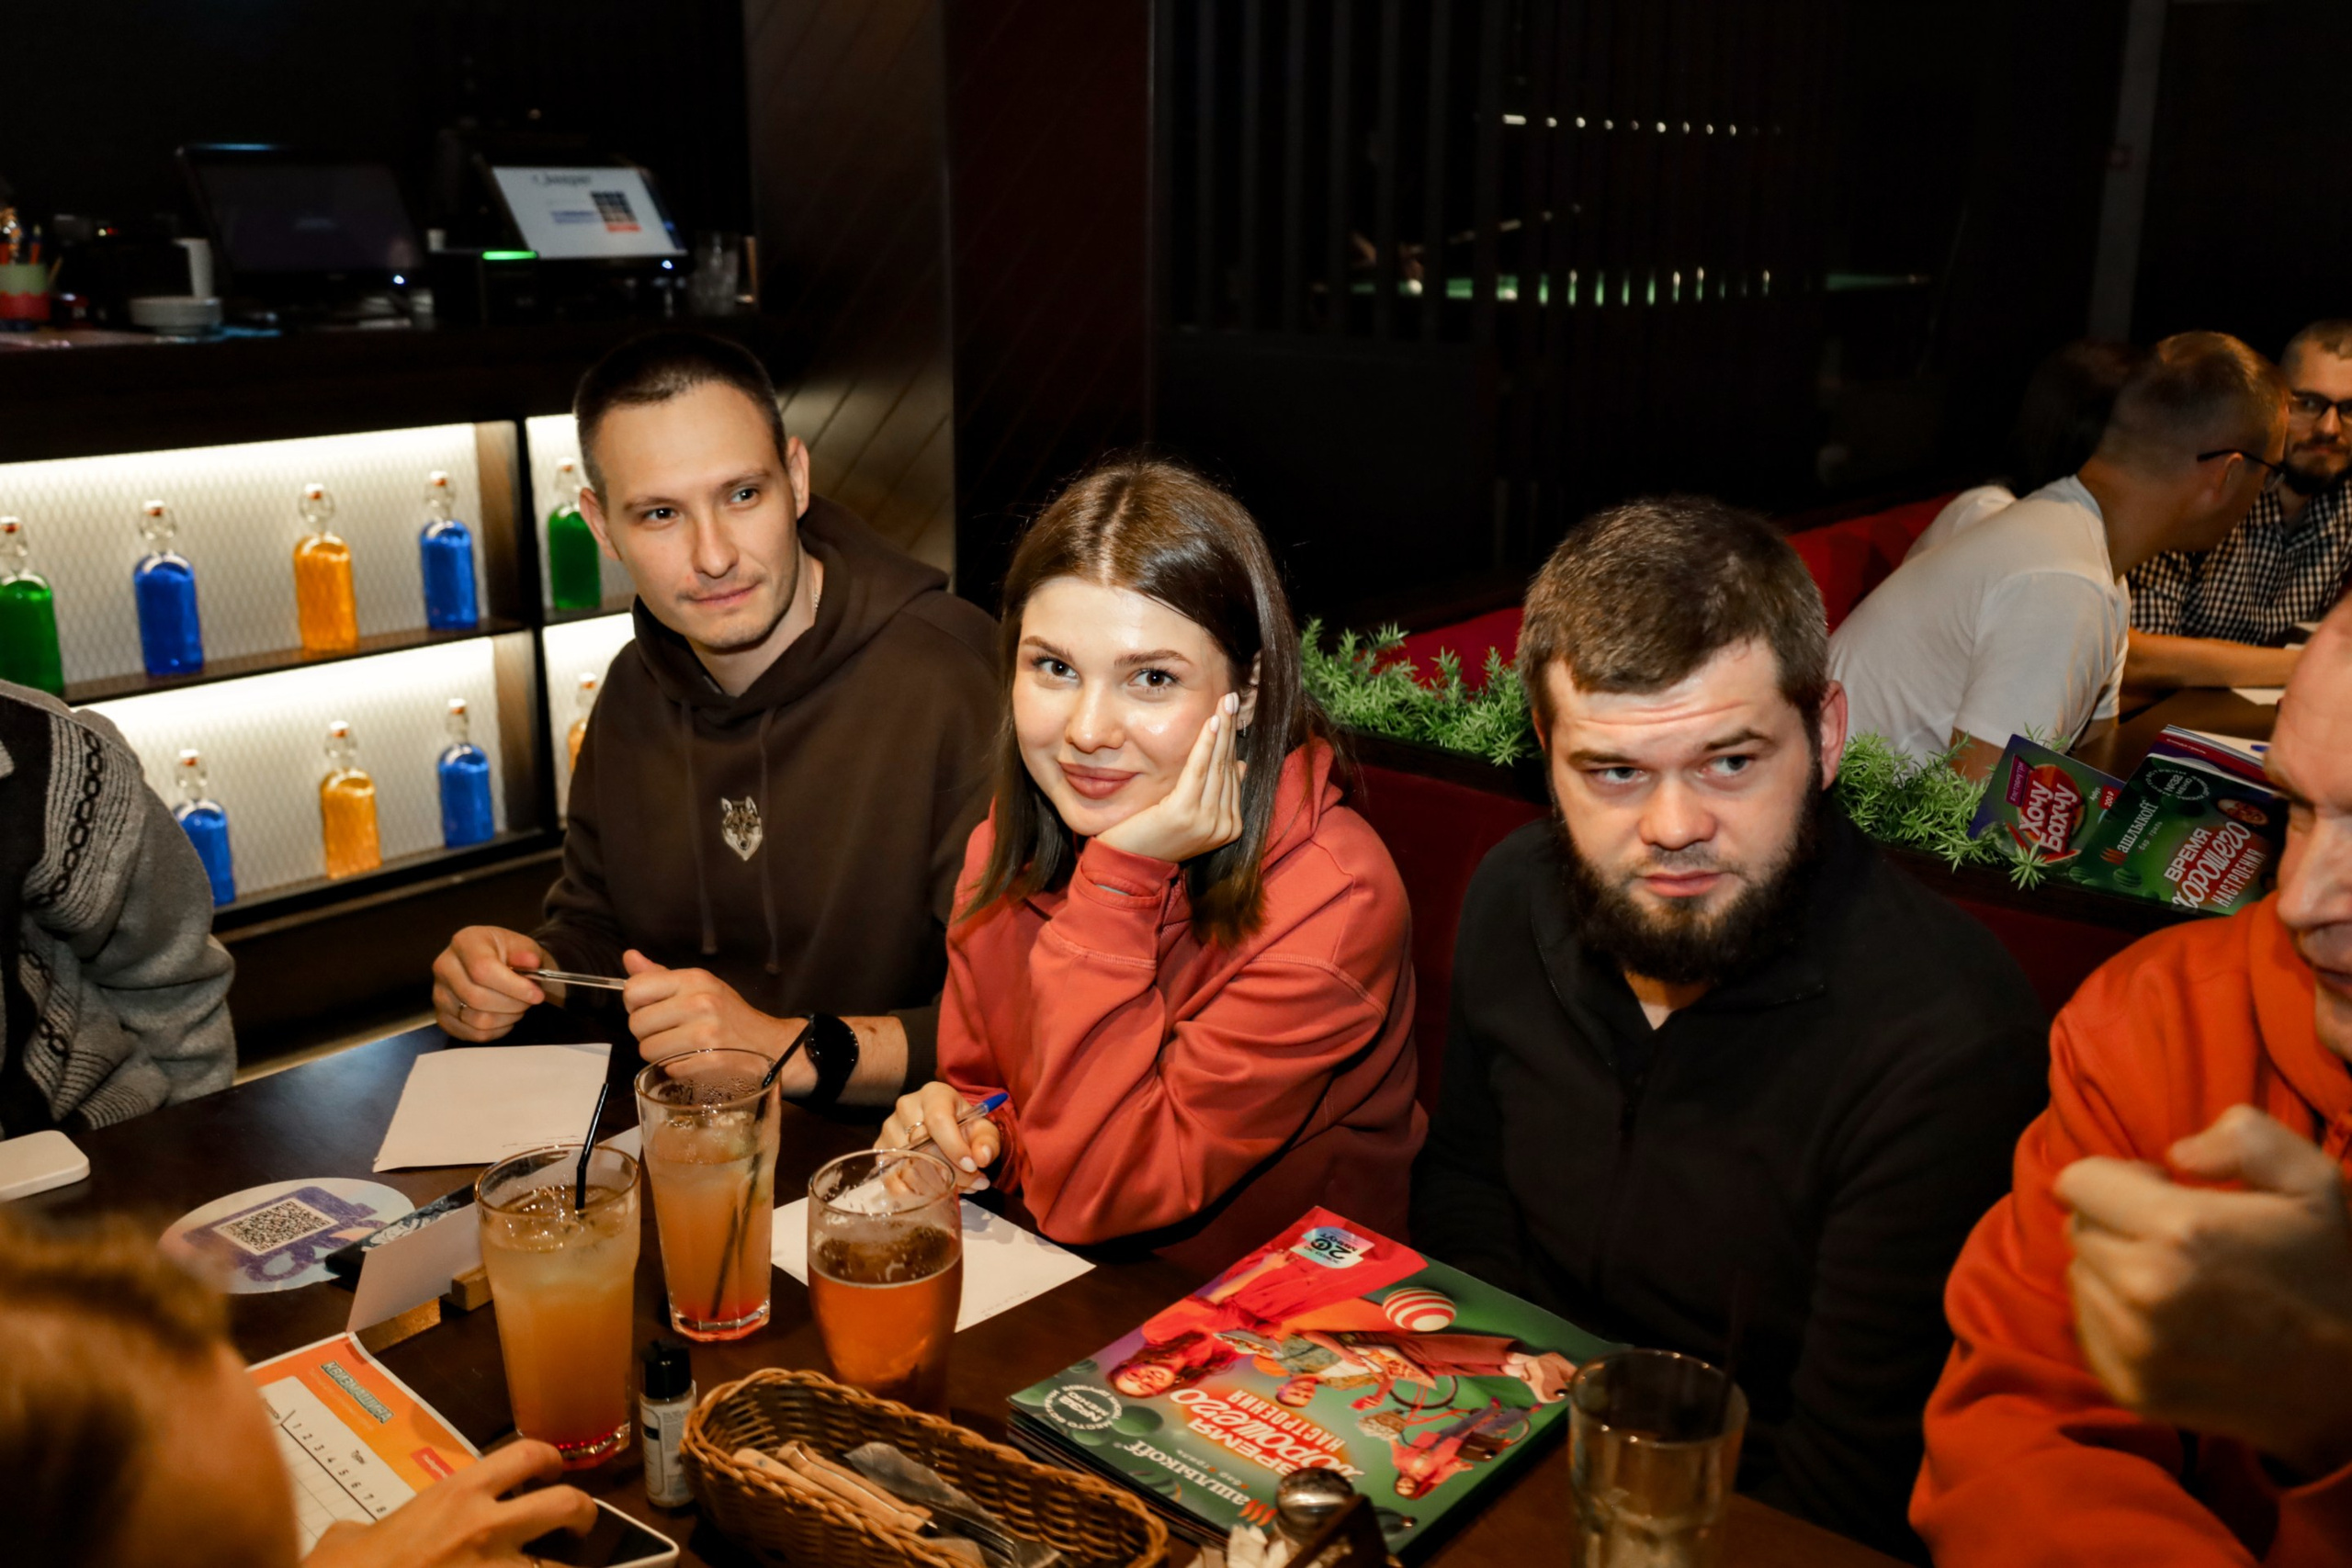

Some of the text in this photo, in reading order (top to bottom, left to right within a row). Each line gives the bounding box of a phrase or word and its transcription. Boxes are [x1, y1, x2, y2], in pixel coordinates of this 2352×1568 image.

[2164, 827, 2212, 882] ВРЕМЯ
[2211, 848, 2267, 908] НАСТРОЕНИЯ
[1227, 1389, 1346, 1452] НАСТРОЕНИЯ
